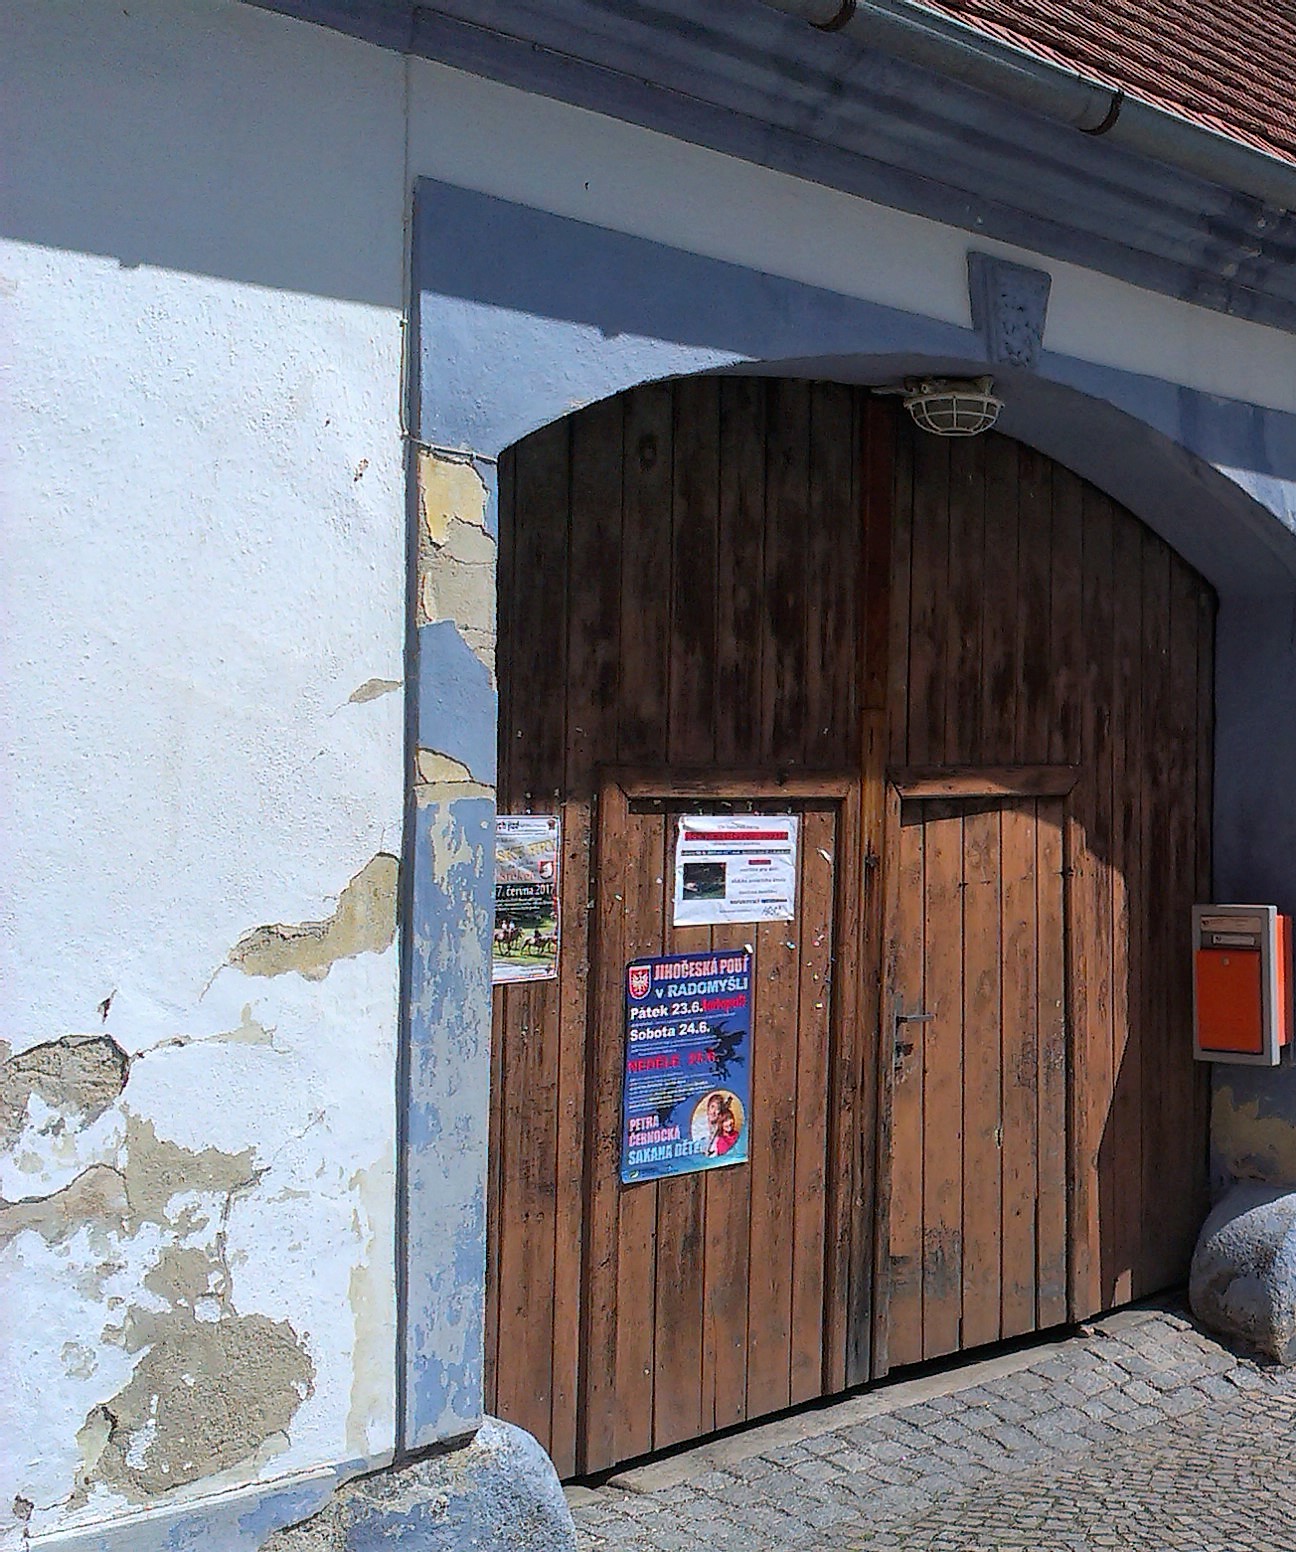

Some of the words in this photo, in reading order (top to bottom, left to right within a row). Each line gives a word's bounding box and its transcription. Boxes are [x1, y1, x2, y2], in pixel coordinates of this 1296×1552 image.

[535, 884, 555, 896] 2017
[654, 957, 718, 980] JIHOČESKÁ
[667, 976, 748, 998] RADOMYŠLI
[630, 1004, 669, 1020] Pátek
[671, 1001, 704, 1016] 23.6.
[630, 1026, 676, 1041] Sobota
[678, 1021, 711, 1036] 24.6.
[629, 1115, 660, 1132] PETRA
